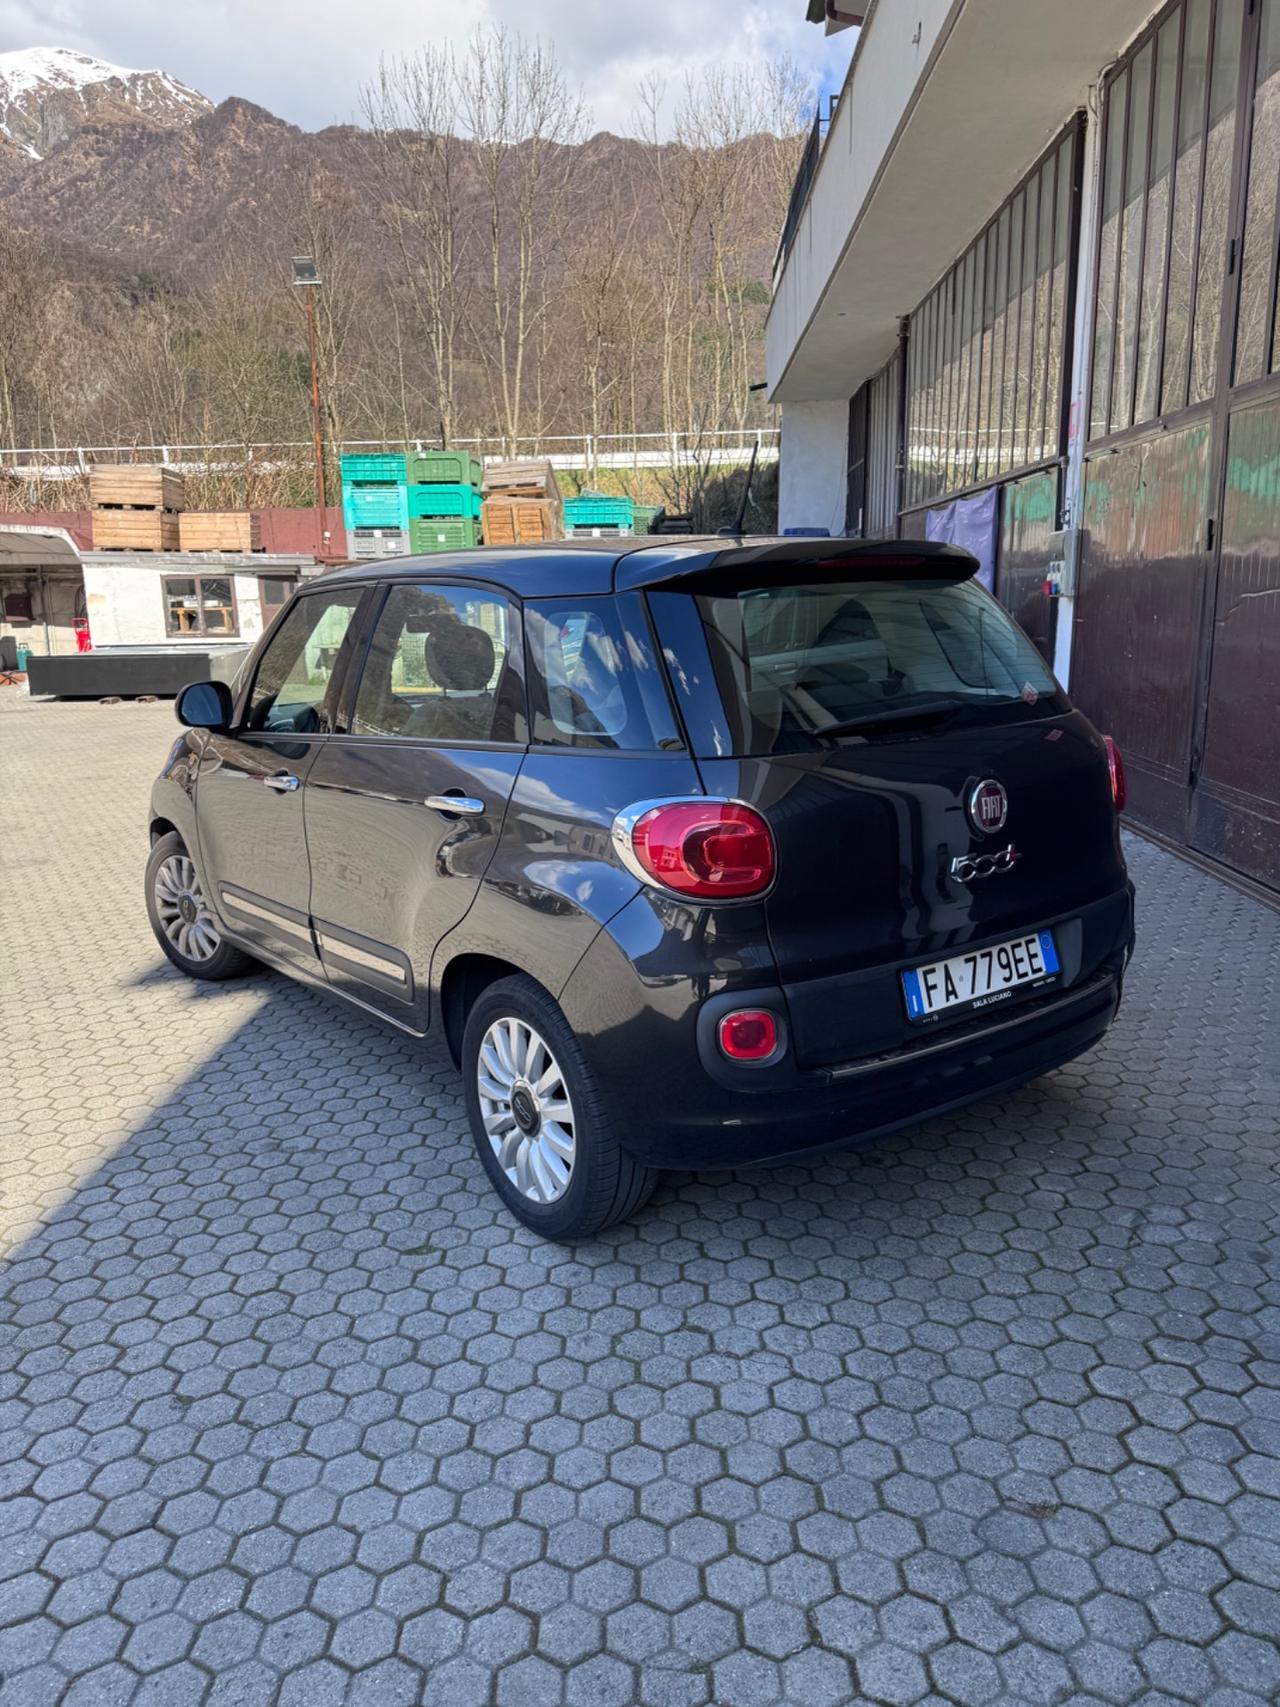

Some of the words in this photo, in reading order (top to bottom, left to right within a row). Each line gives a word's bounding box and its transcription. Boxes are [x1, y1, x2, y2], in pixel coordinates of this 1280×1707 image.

[981, 795, 1001, 819] FIAT
[922, 963, 958, 1008] FA
[964, 938, 1043, 995] 779EE
[973, 998, 989, 1009] SALA
[988, 990, 1012, 1004] LUCIANO
